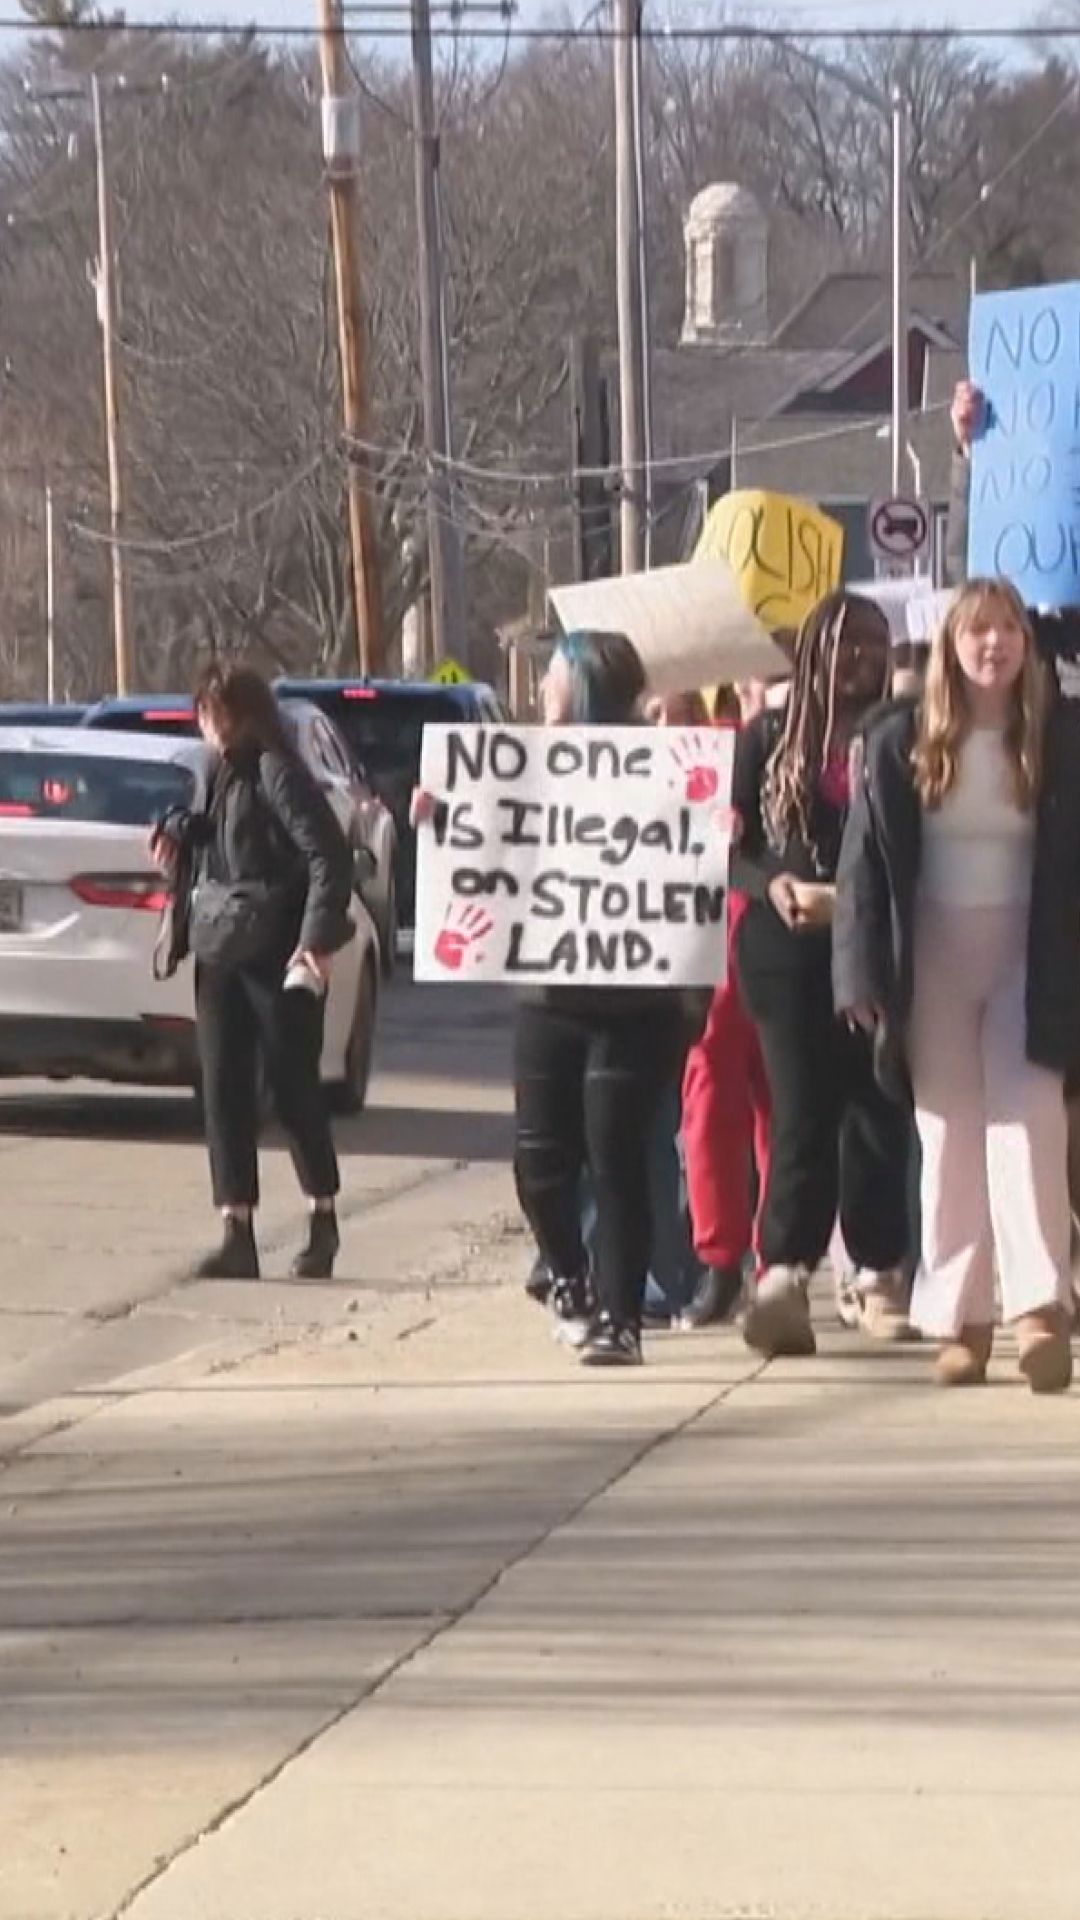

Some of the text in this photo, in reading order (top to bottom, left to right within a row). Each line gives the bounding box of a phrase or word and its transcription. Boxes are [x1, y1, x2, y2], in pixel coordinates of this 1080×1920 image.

[984, 304, 1061, 376] NO
[990, 378, 1056, 437] NO
[979, 455, 1052, 503] NO
[722, 504, 836, 599] OLISH
[446, 729, 652, 792] NO one
[433, 798, 705, 865] IS Illegal.
[452, 868, 724, 925] on STOLEN
[504, 922, 670, 973] LAND.
